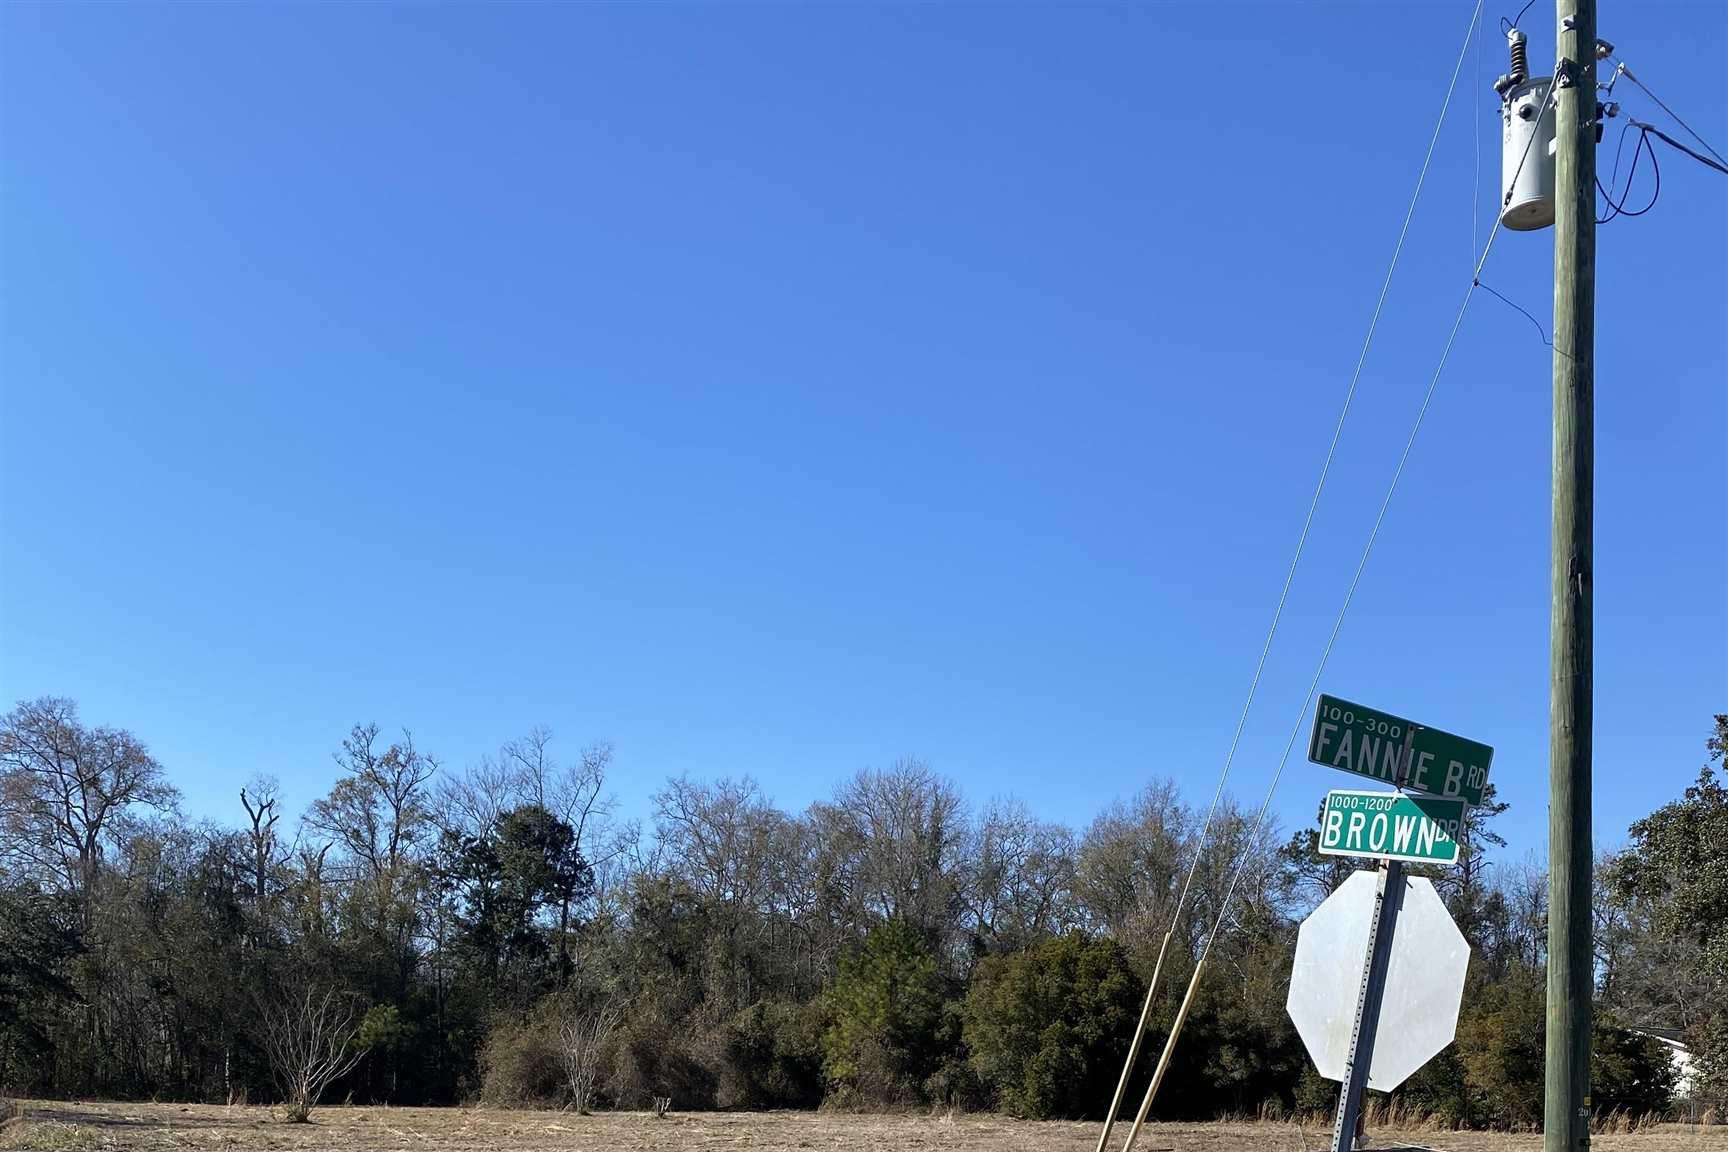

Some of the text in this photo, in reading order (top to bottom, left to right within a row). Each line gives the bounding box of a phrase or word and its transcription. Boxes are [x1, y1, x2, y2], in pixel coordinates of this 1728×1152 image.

[1323, 704, 1401, 738] 100-300
[1315, 722, 1485, 797] FANNIE B RD
[1330, 796, 1392, 811] 1000-1200
[1323, 810, 1459, 856] BROWN DR
